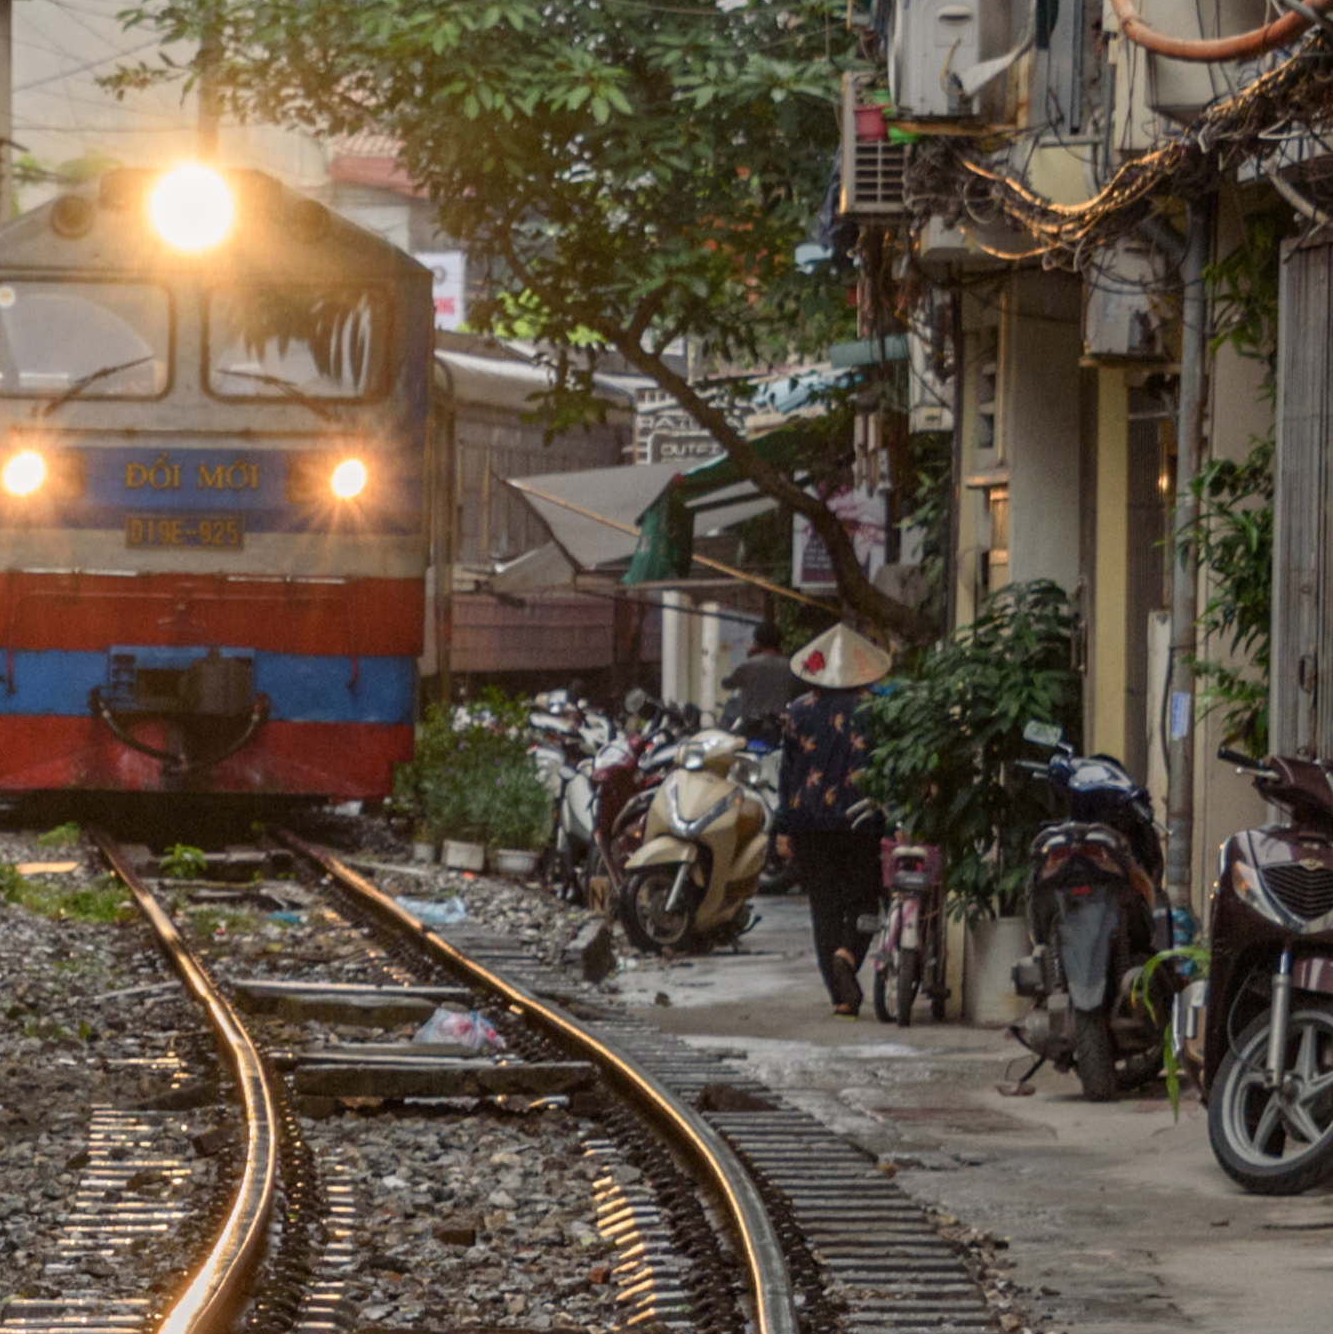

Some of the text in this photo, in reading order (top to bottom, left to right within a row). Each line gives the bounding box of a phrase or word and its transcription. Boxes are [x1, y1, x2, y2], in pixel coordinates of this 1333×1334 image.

[125, 450, 260, 490] ĐỔI MỚI
[130, 518, 240, 546] D19E-925
